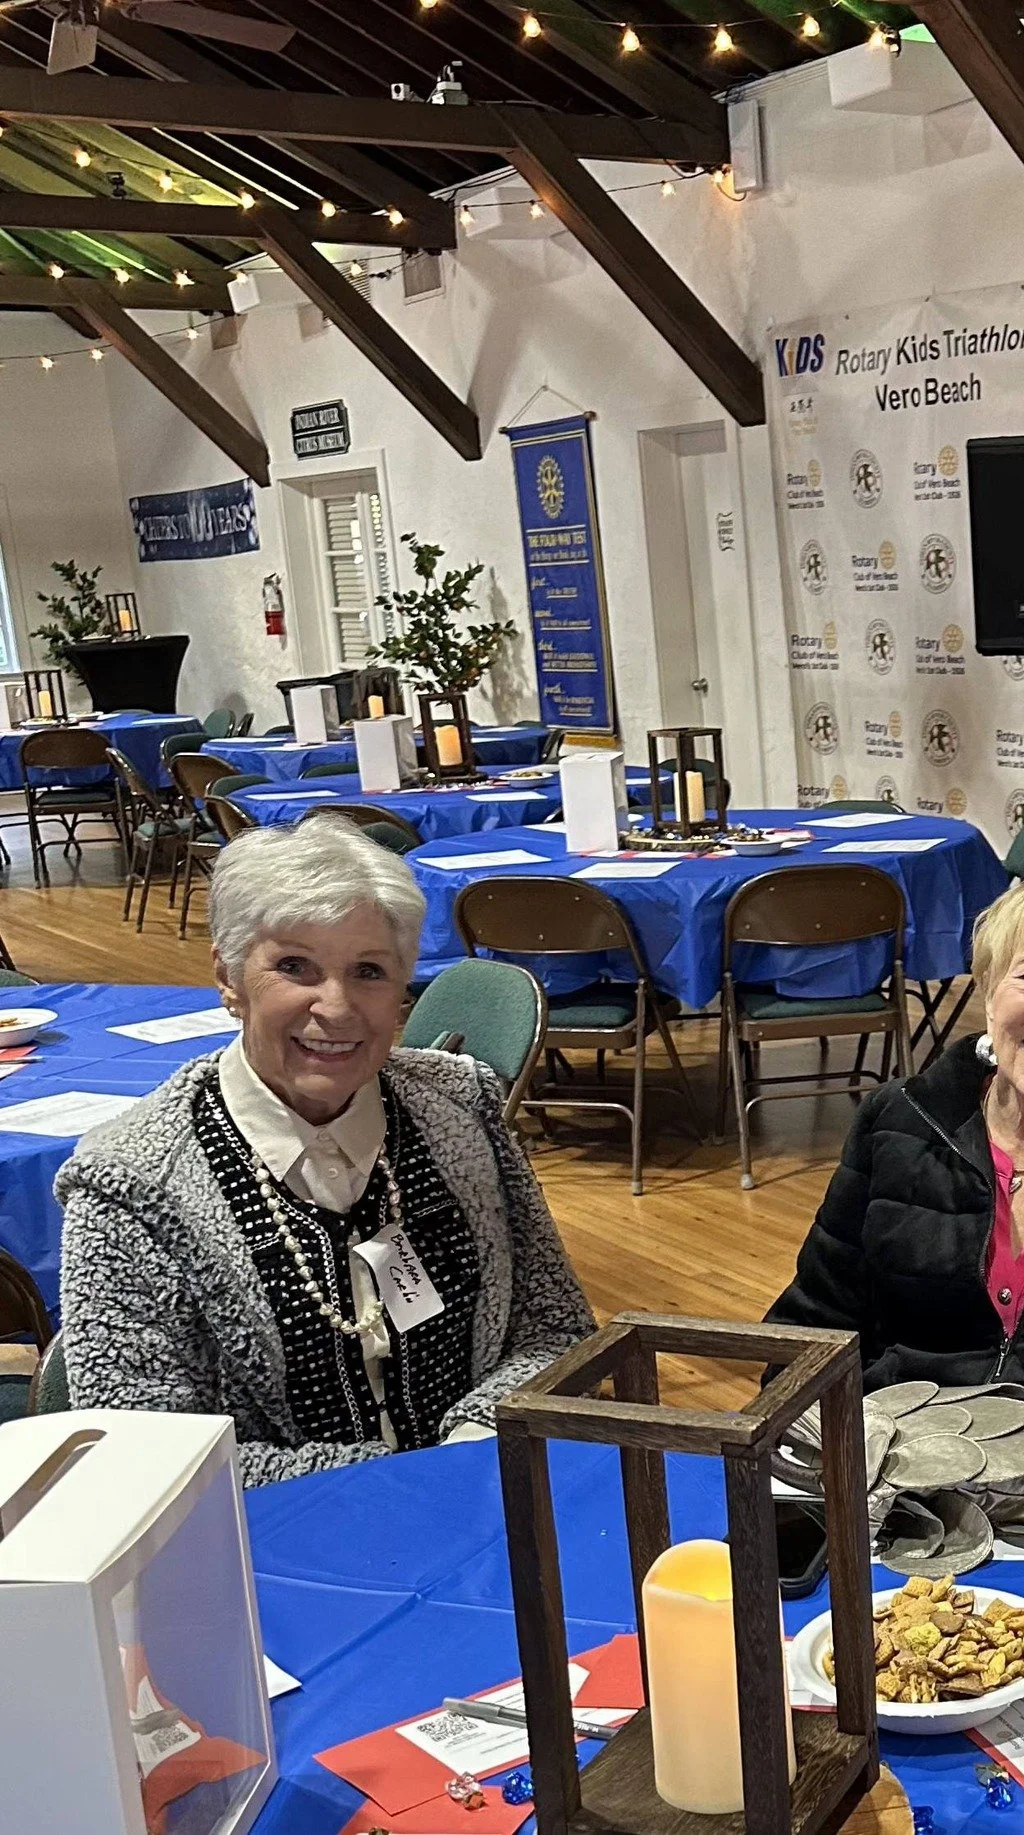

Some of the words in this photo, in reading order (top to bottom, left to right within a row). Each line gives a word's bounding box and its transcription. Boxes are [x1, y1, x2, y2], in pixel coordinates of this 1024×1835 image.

[775, 333, 825, 377] KIDS
[835, 348, 891, 377] Rotary
[895, 332, 941, 366] Kids
[875, 383, 921, 412] Vero
[924, 372, 982, 406] Beach
[211, 503, 247, 536] YEARS
[791, 633, 822, 650] Rotary
[865, 720, 888, 736] Rotary
[996, 729, 1024, 746] Rotary
[797, 784, 830, 800] Rotary
[917, 797, 944, 813] Rotary
